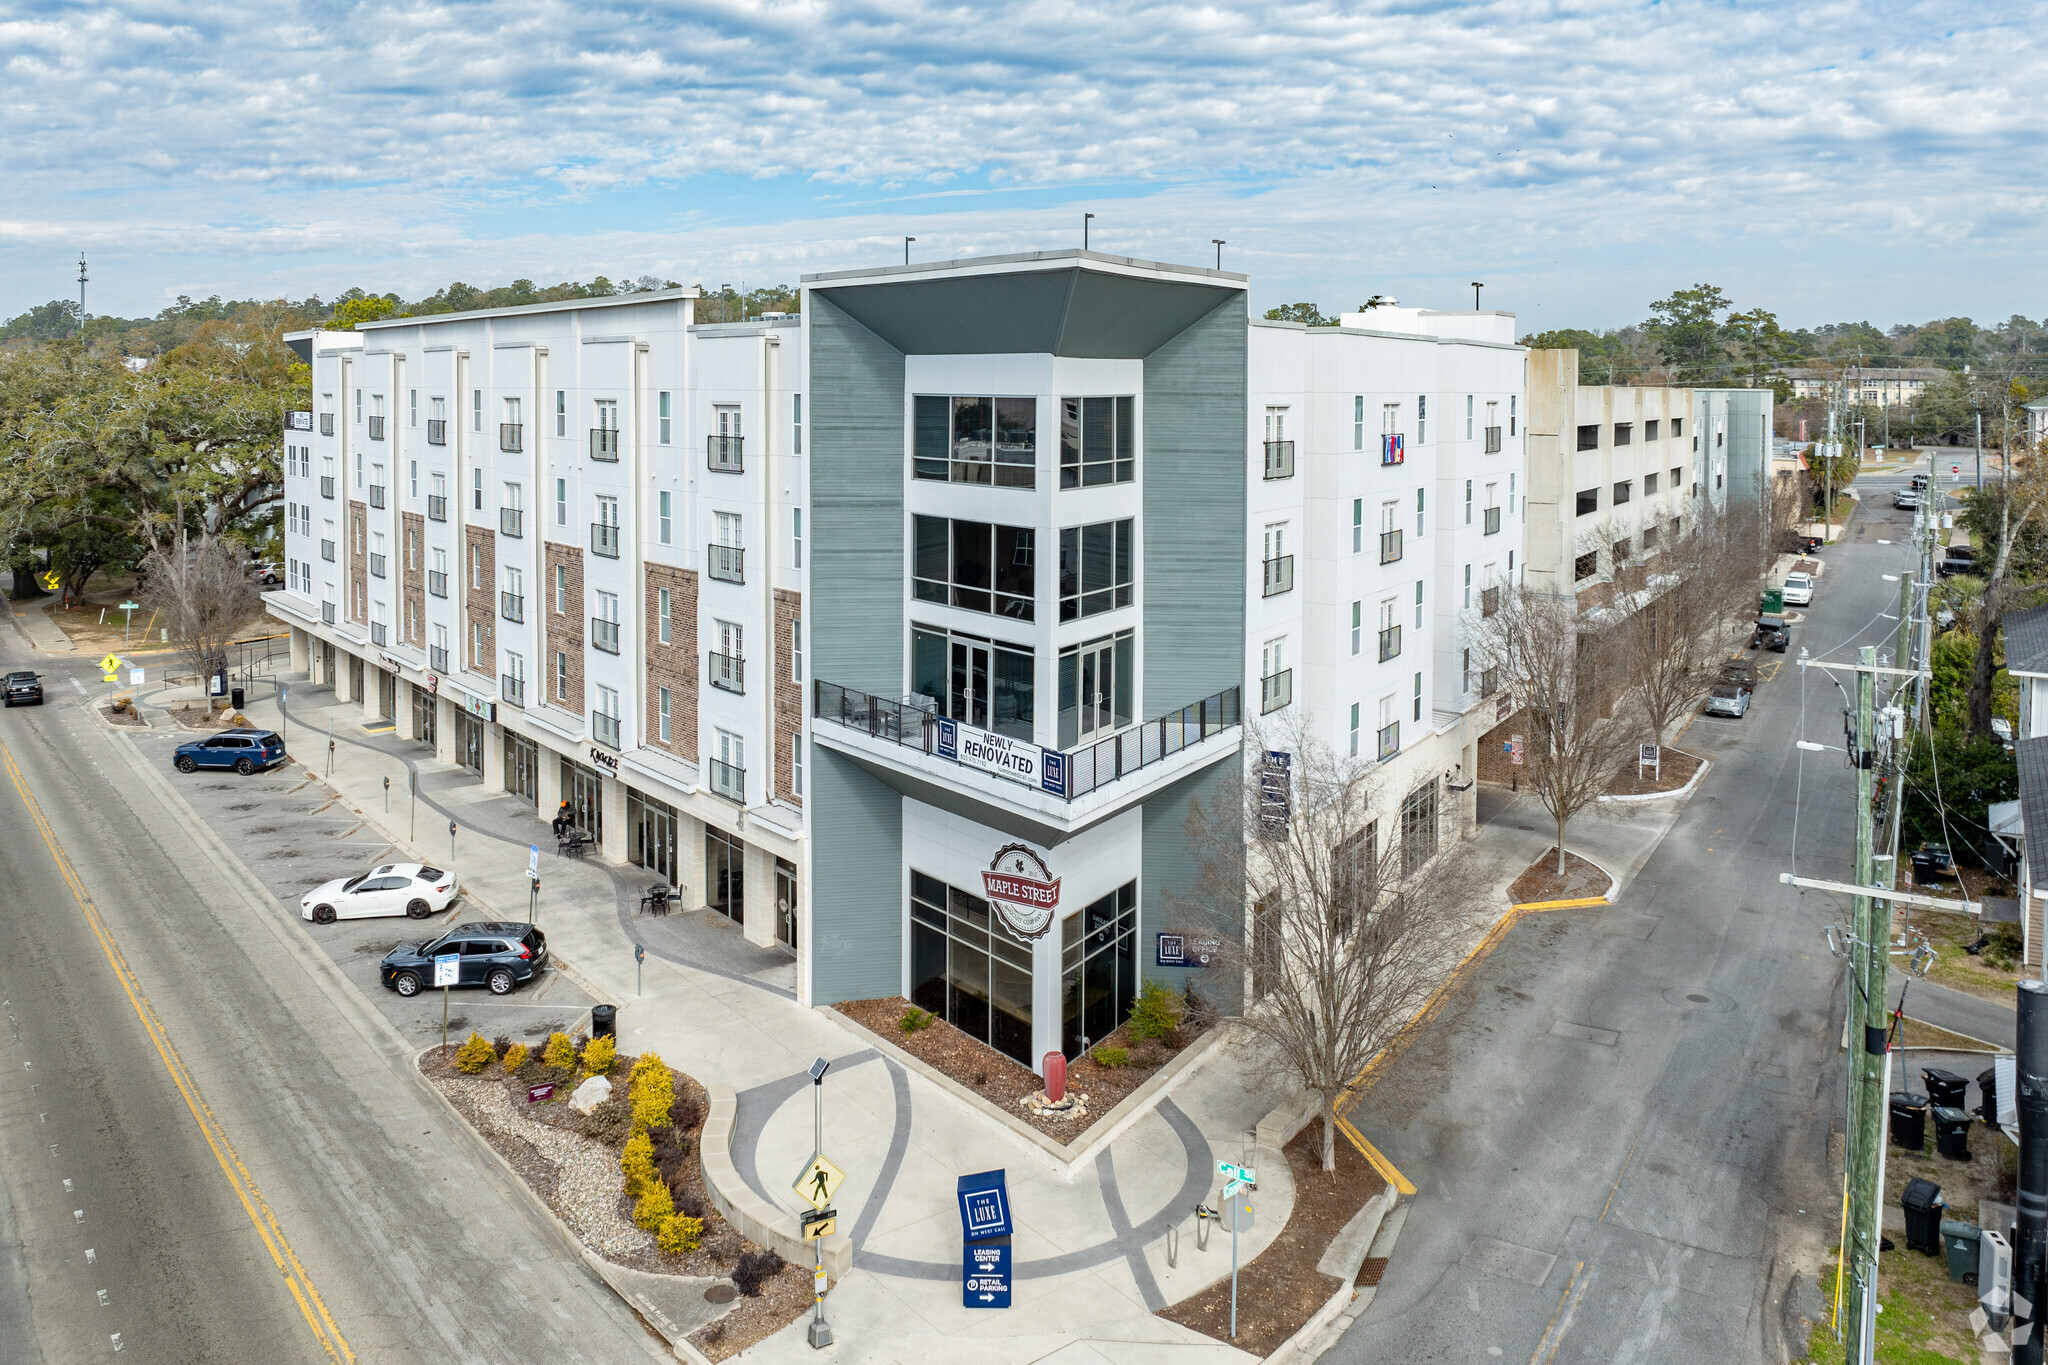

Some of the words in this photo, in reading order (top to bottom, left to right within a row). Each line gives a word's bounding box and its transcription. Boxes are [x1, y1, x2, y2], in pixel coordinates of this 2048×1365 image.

[983, 732, 1013, 751] NEWLY
[964, 739, 1033, 774] RENOVATED
[1047, 765, 1059, 779] LUXE
[987, 878, 1020, 897] MAPLE
[1021, 885, 1058, 903] STREET
[1164, 946, 1180, 955] LUXE
[1218, 1162, 1240, 1180] Call
[1244, 1169, 1254, 1180] St
[976, 1198, 990, 1206] THE
[974, 1205, 997, 1223] LUXE
